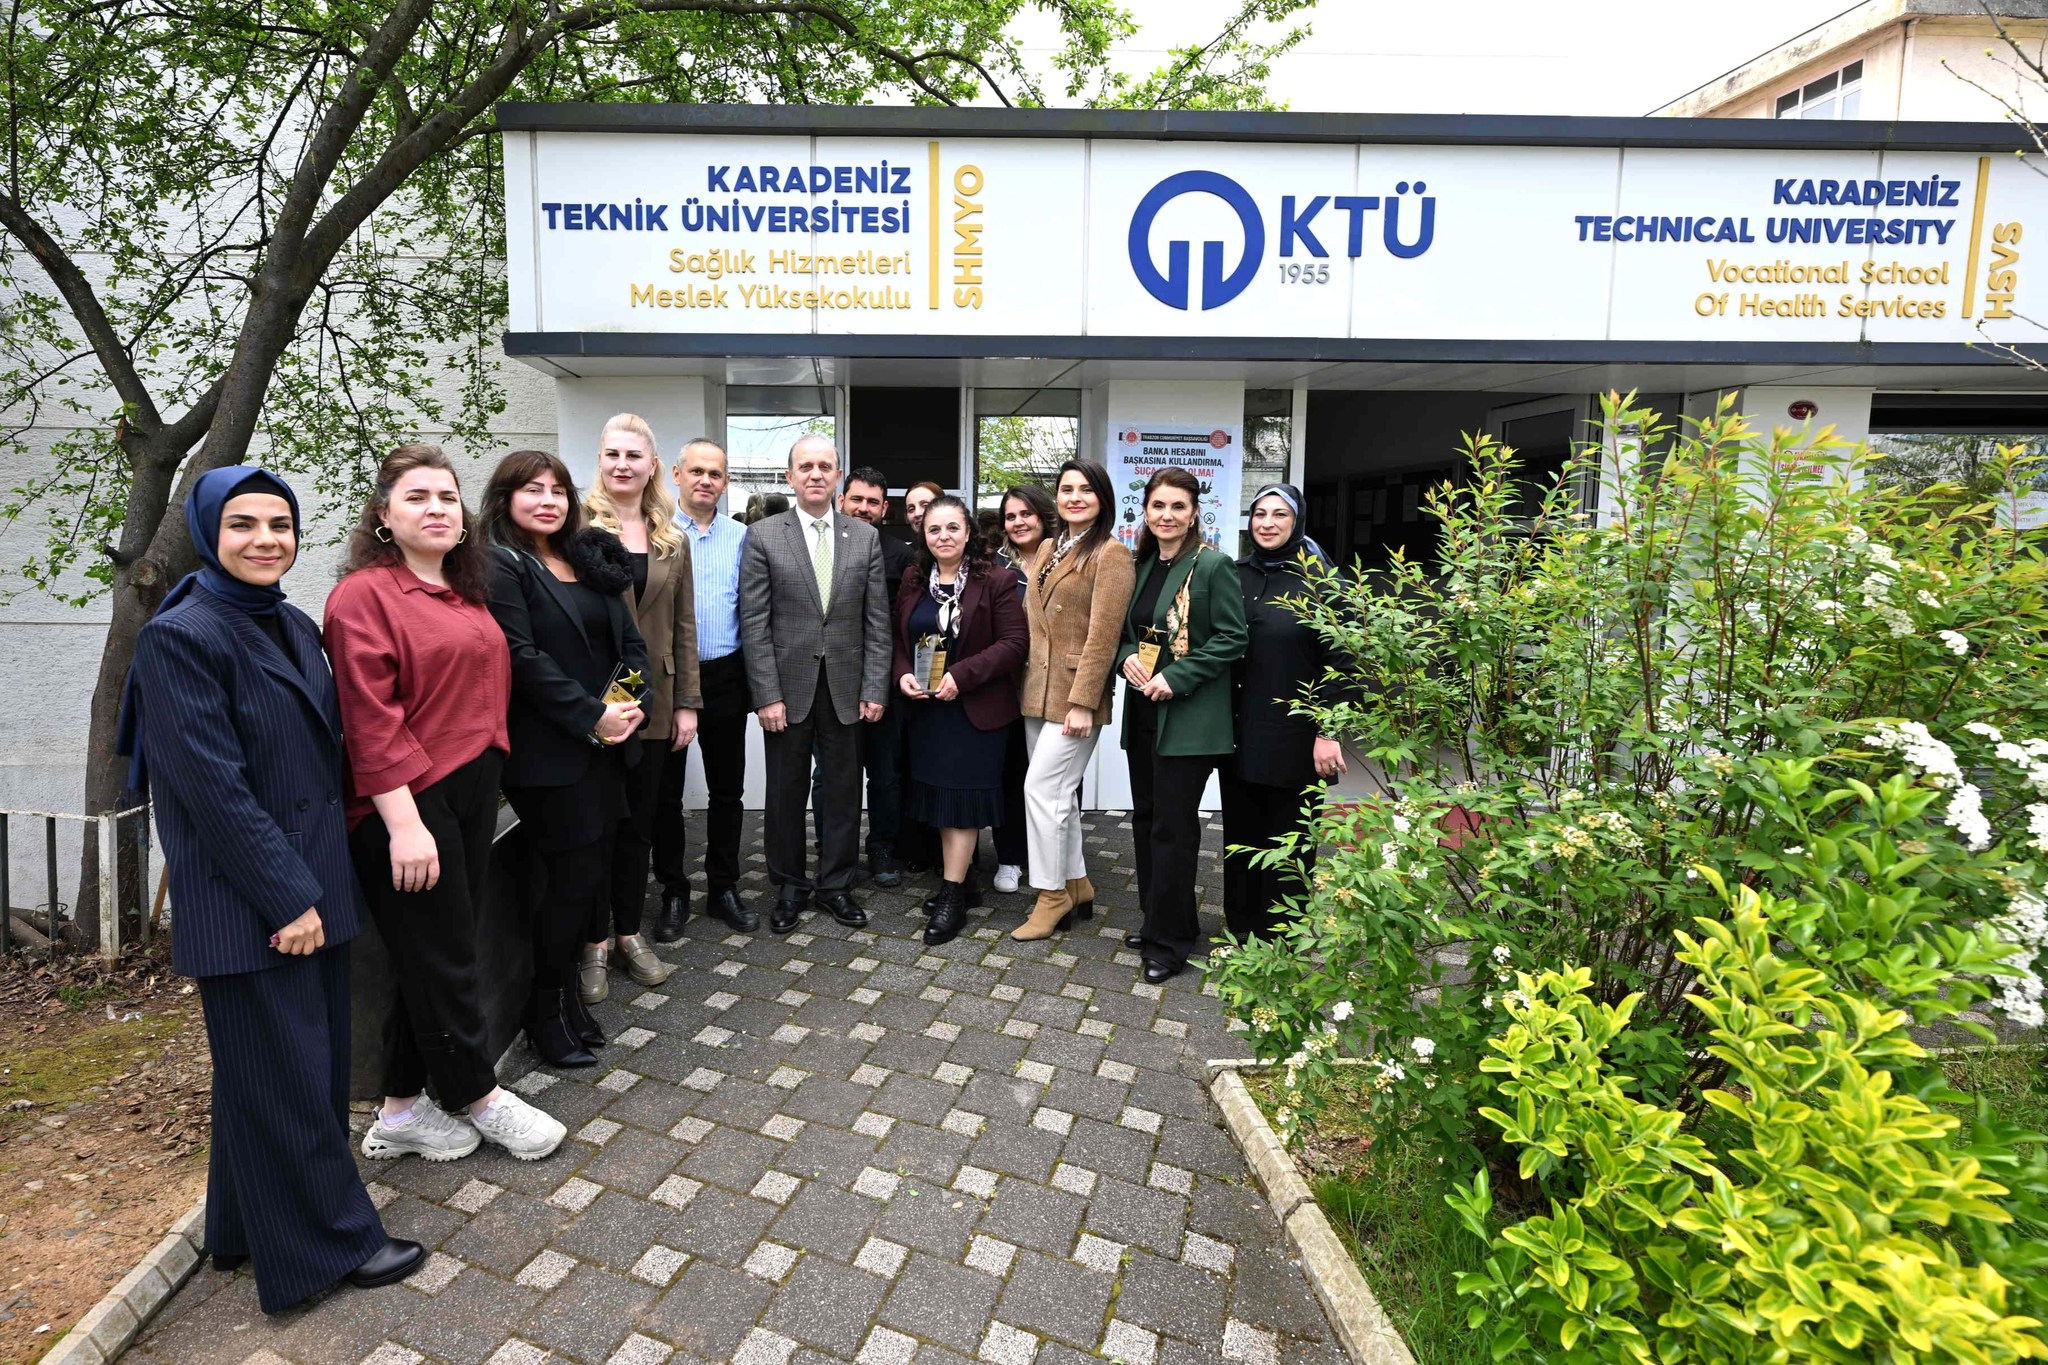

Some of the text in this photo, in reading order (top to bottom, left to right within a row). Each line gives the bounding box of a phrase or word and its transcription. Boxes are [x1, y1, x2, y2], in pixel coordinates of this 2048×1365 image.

[708, 159, 911, 194] KARADENİZ
[1774, 174, 1960, 207] KARADENİZ
[542, 197, 910, 233] TEKNİK ÜNİVERSİTESİ
[1279, 181, 1436, 259] KTÜ
[1575, 215, 1955, 245] TECHNICAL UNIVERSITY
[953, 164, 984, 309] SHMYO
[669, 248, 911, 280] Sağlık Hizmetleri
[1279, 264, 1330, 285] 1955
[1706, 259, 1949, 285] Vocational School
[1984, 221, 2023, 318] HSVS
[630, 283, 911, 310] Meslek Yüksekokulu
[1695, 292, 1947, 319] Of Health Services
[1123, 456, 1224, 468] BAŞKASINA KULLANDIRMA,
[1143, 447, 1206, 457] BANKA HESABINI
[1188, 467, 1214, 477] OLMA!
